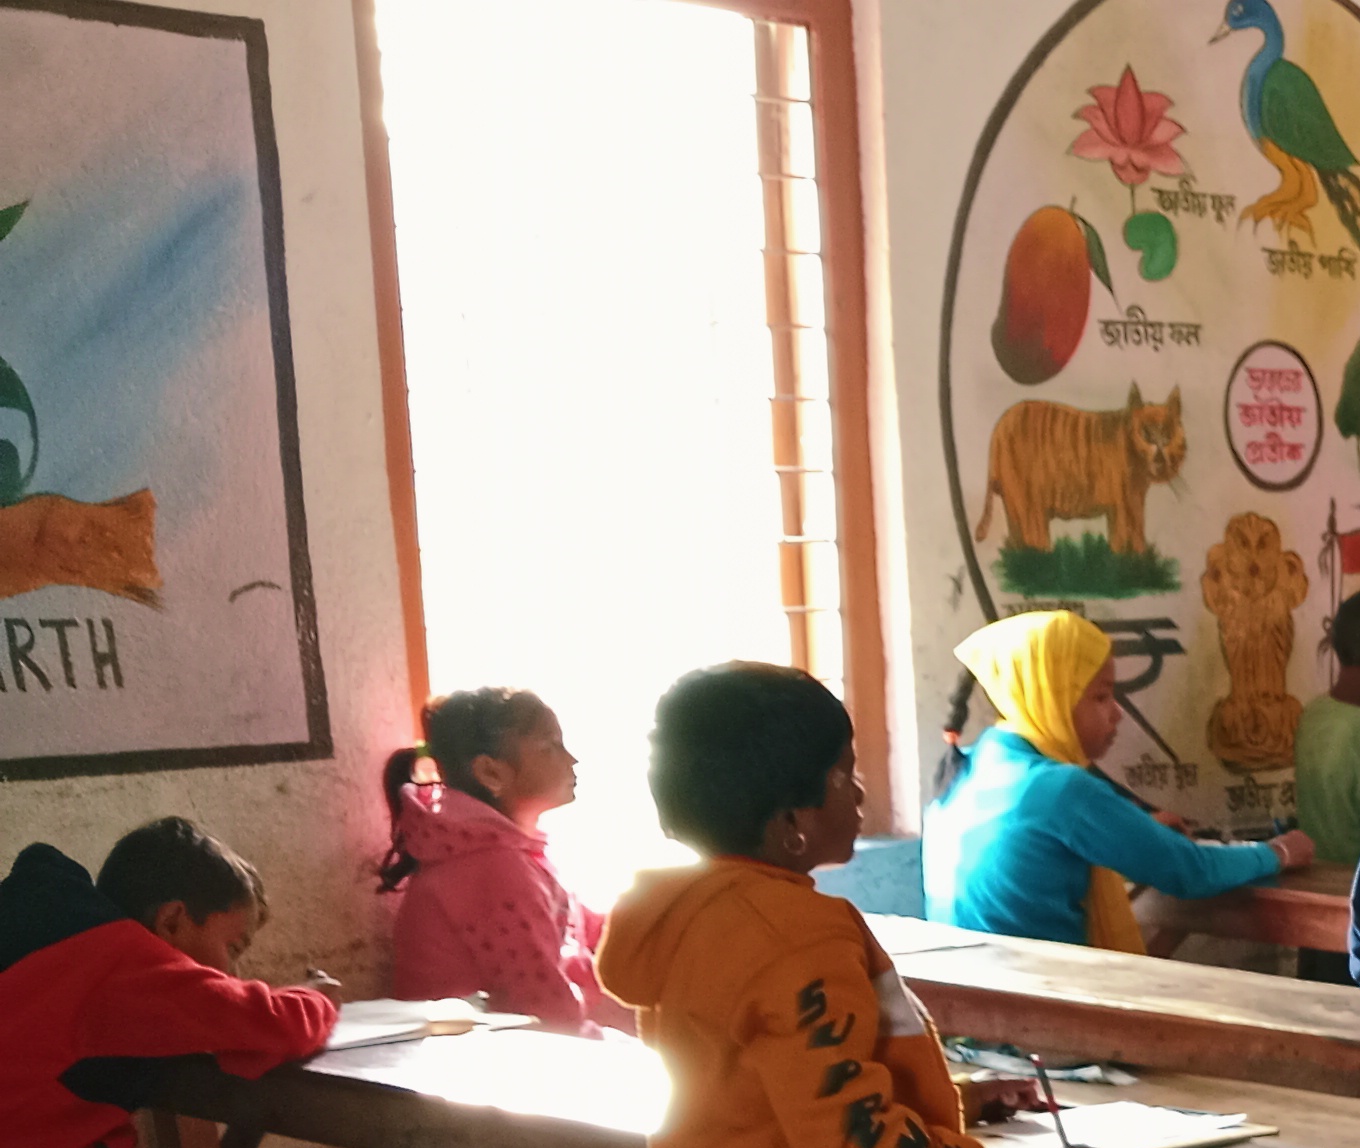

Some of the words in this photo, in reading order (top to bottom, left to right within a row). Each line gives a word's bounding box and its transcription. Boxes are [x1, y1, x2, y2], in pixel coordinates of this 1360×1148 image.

[1098, 304, 1164, 352] জাতীয়
[1169, 321, 1202, 346] ফল
[0, 617, 124, 692] RTH
